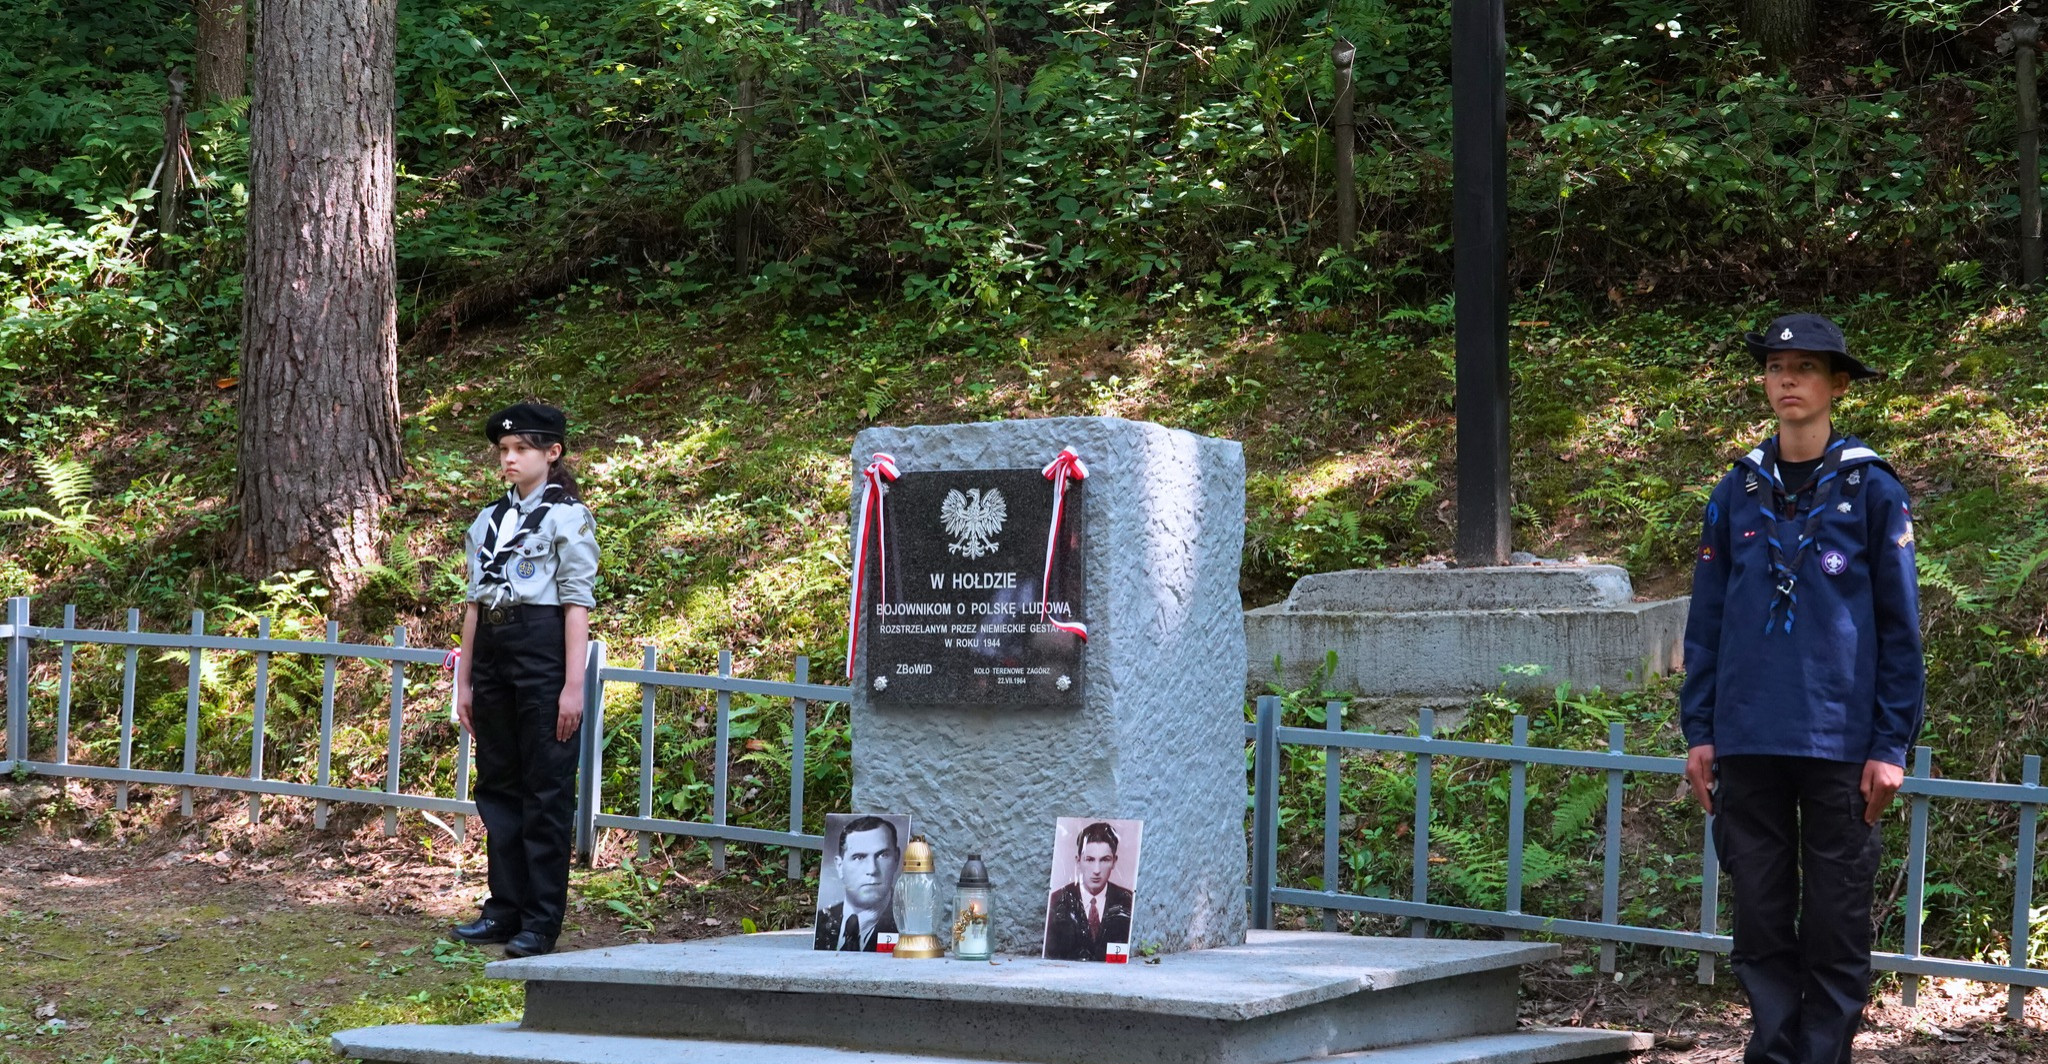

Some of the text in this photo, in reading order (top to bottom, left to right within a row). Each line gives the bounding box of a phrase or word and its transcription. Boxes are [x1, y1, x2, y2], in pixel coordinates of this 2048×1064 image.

[930, 572, 1017, 590] W HOŁDZIE
[876, 602, 1072, 618] BOJOWNIKOM O POLSKĘ LUDOWĄ
[880, 625, 948, 634] ROZSTRZELANYM
[951, 624, 977, 634] PRZEZ
[980, 624, 1026, 633] NIEMIECKIE
[944, 639, 1000, 648] W ROKU 1944
[896, 664, 933, 675] ZBoWiD
[1026, 667, 1051, 675] ZAGÓRZ
